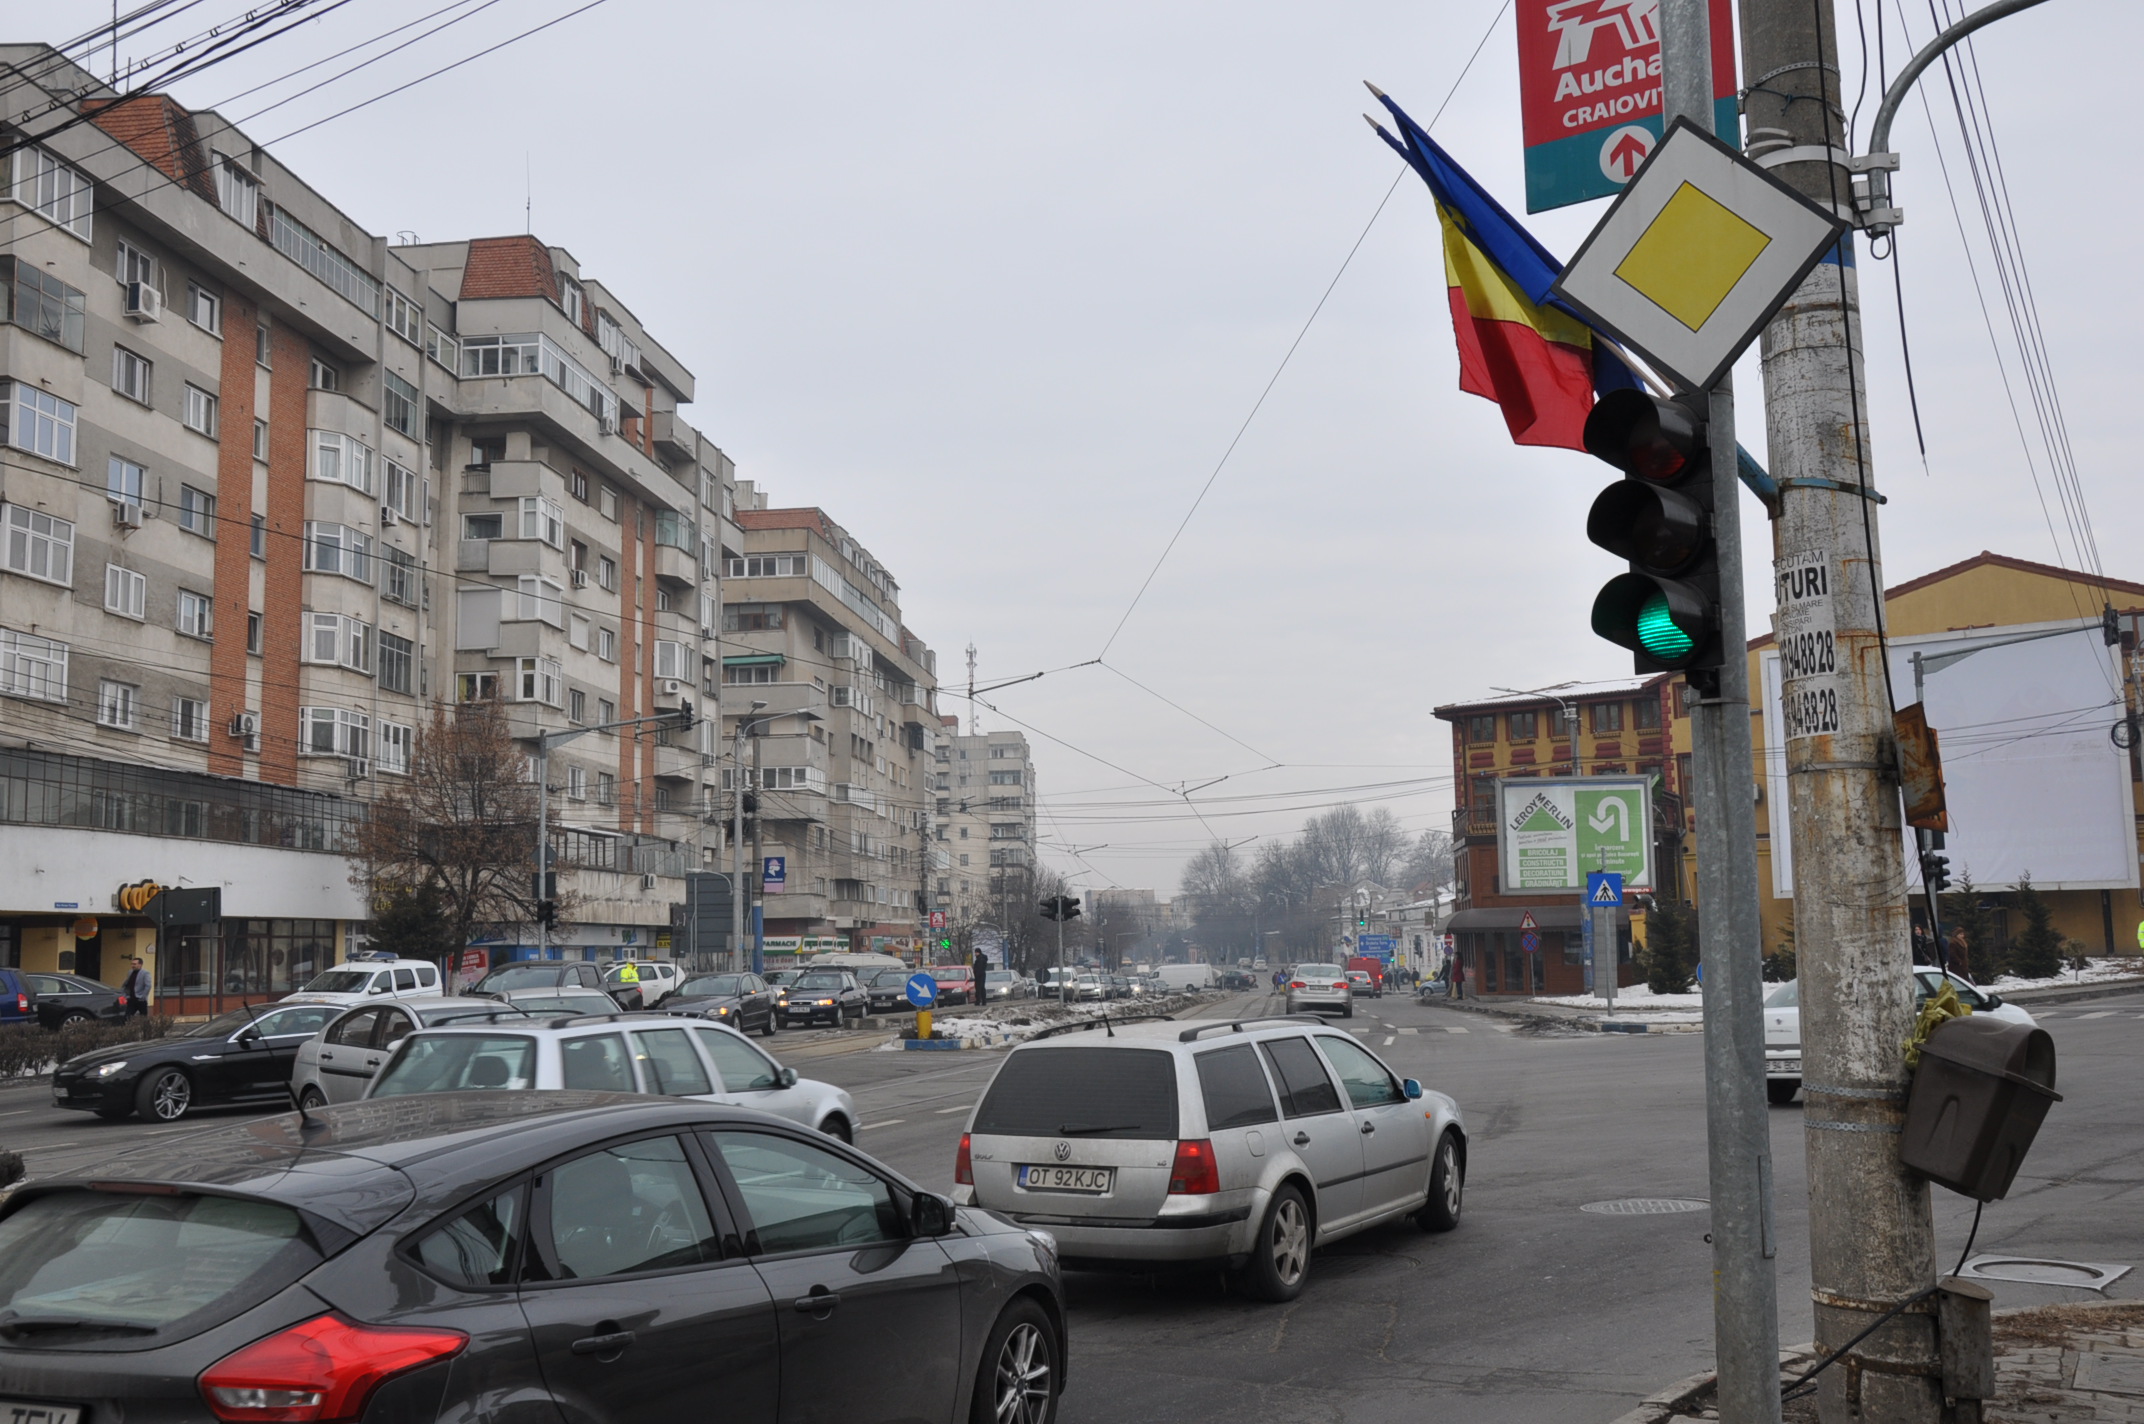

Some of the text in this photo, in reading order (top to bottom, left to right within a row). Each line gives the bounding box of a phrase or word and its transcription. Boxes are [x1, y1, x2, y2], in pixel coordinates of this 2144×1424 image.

[1554, 53, 1662, 103] Aucha
[1509, 792, 1574, 831] LEROY MERLIN
[1527, 849, 1558, 857] BRICOLAJ
[1029, 1168, 1106, 1189] OT 92 KJC
